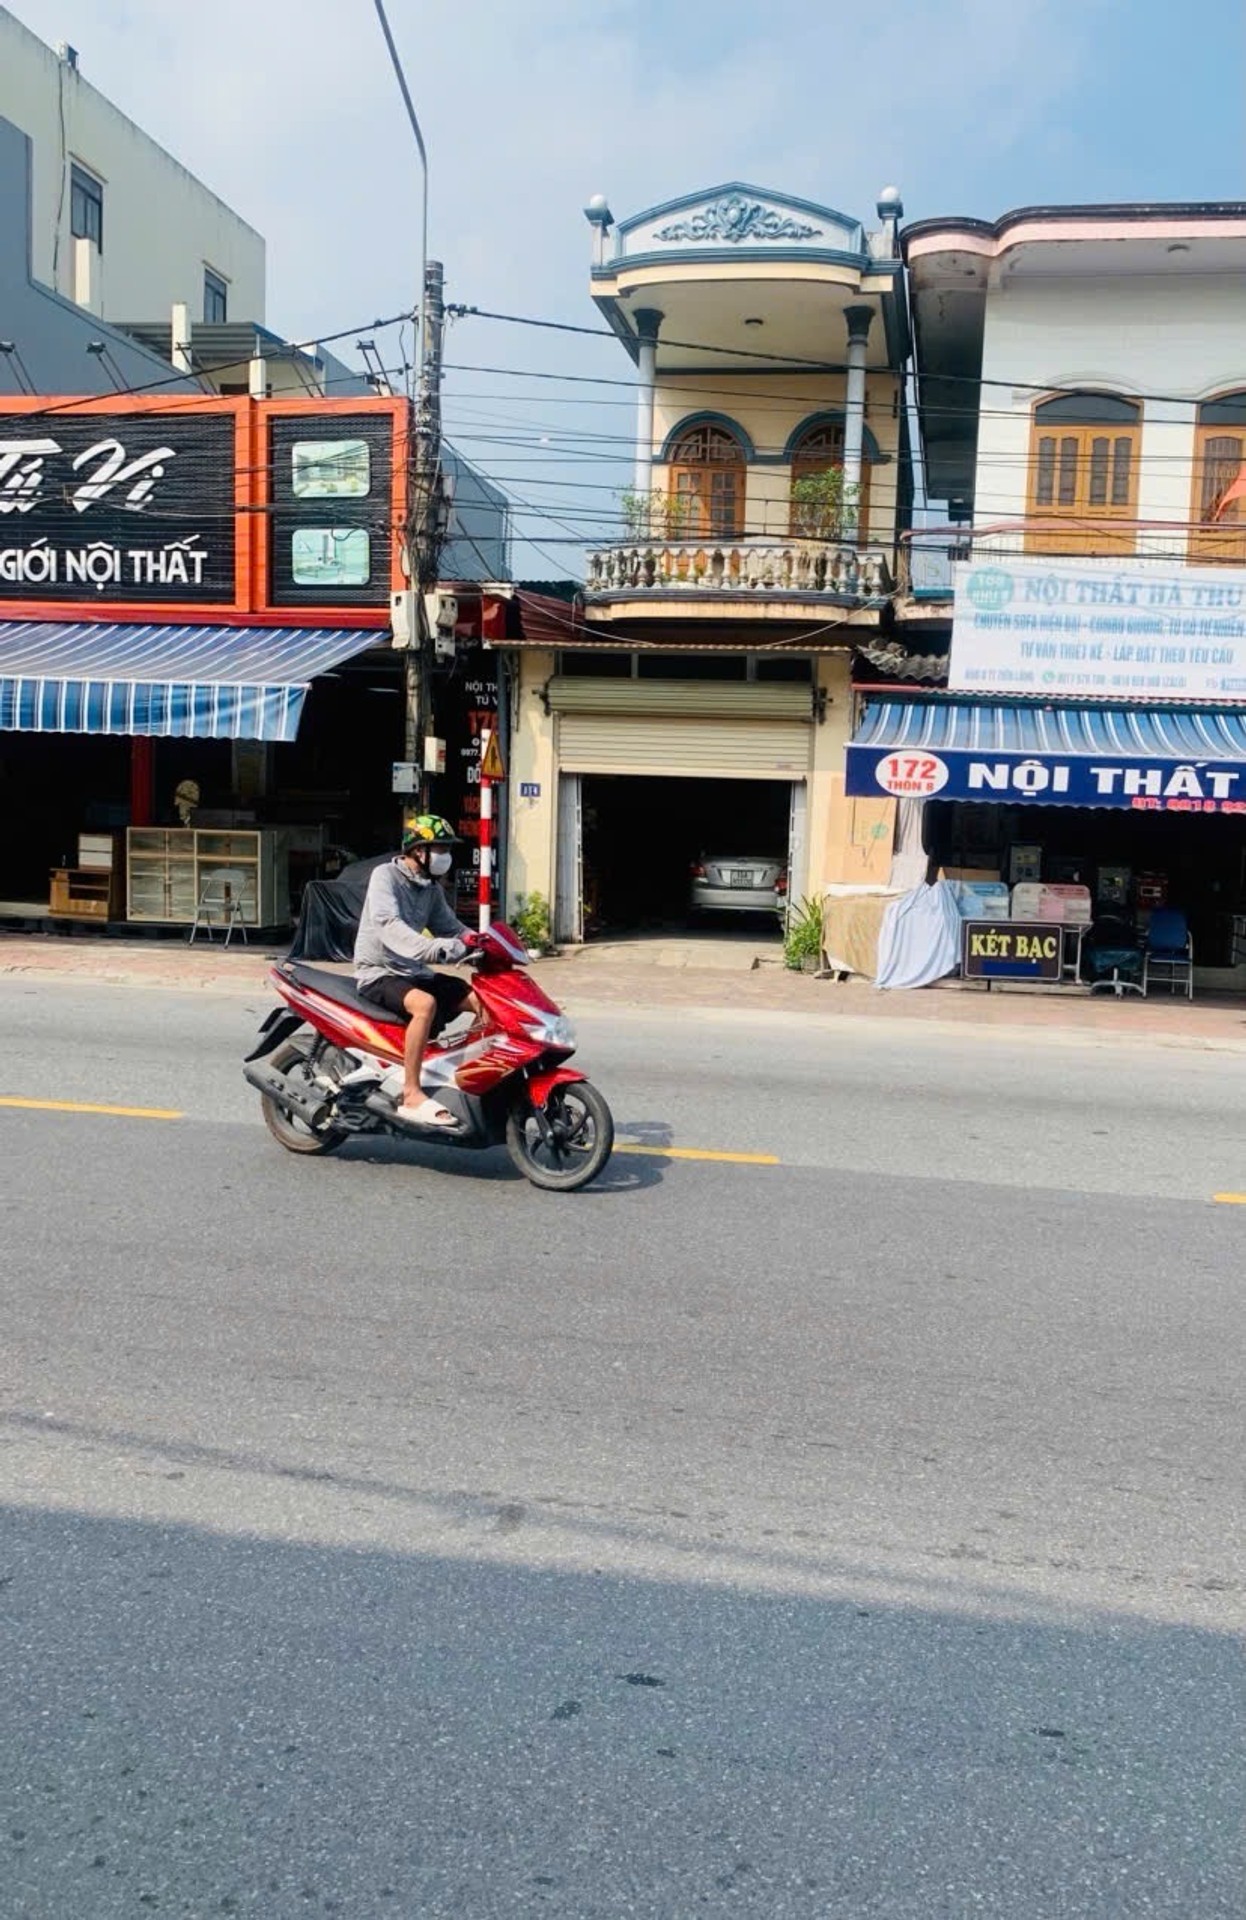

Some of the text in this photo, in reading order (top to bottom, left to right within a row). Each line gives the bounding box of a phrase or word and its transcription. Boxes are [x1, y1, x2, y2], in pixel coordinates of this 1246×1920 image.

[0, 534, 208, 590] GIỚI NỘI THẤT
[888, 759, 937, 778] 172
[968, 759, 1240, 798] NỘI THẤT
[926, 782, 934, 792] 8
[971, 929, 1057, 964] KÉT BẠC
